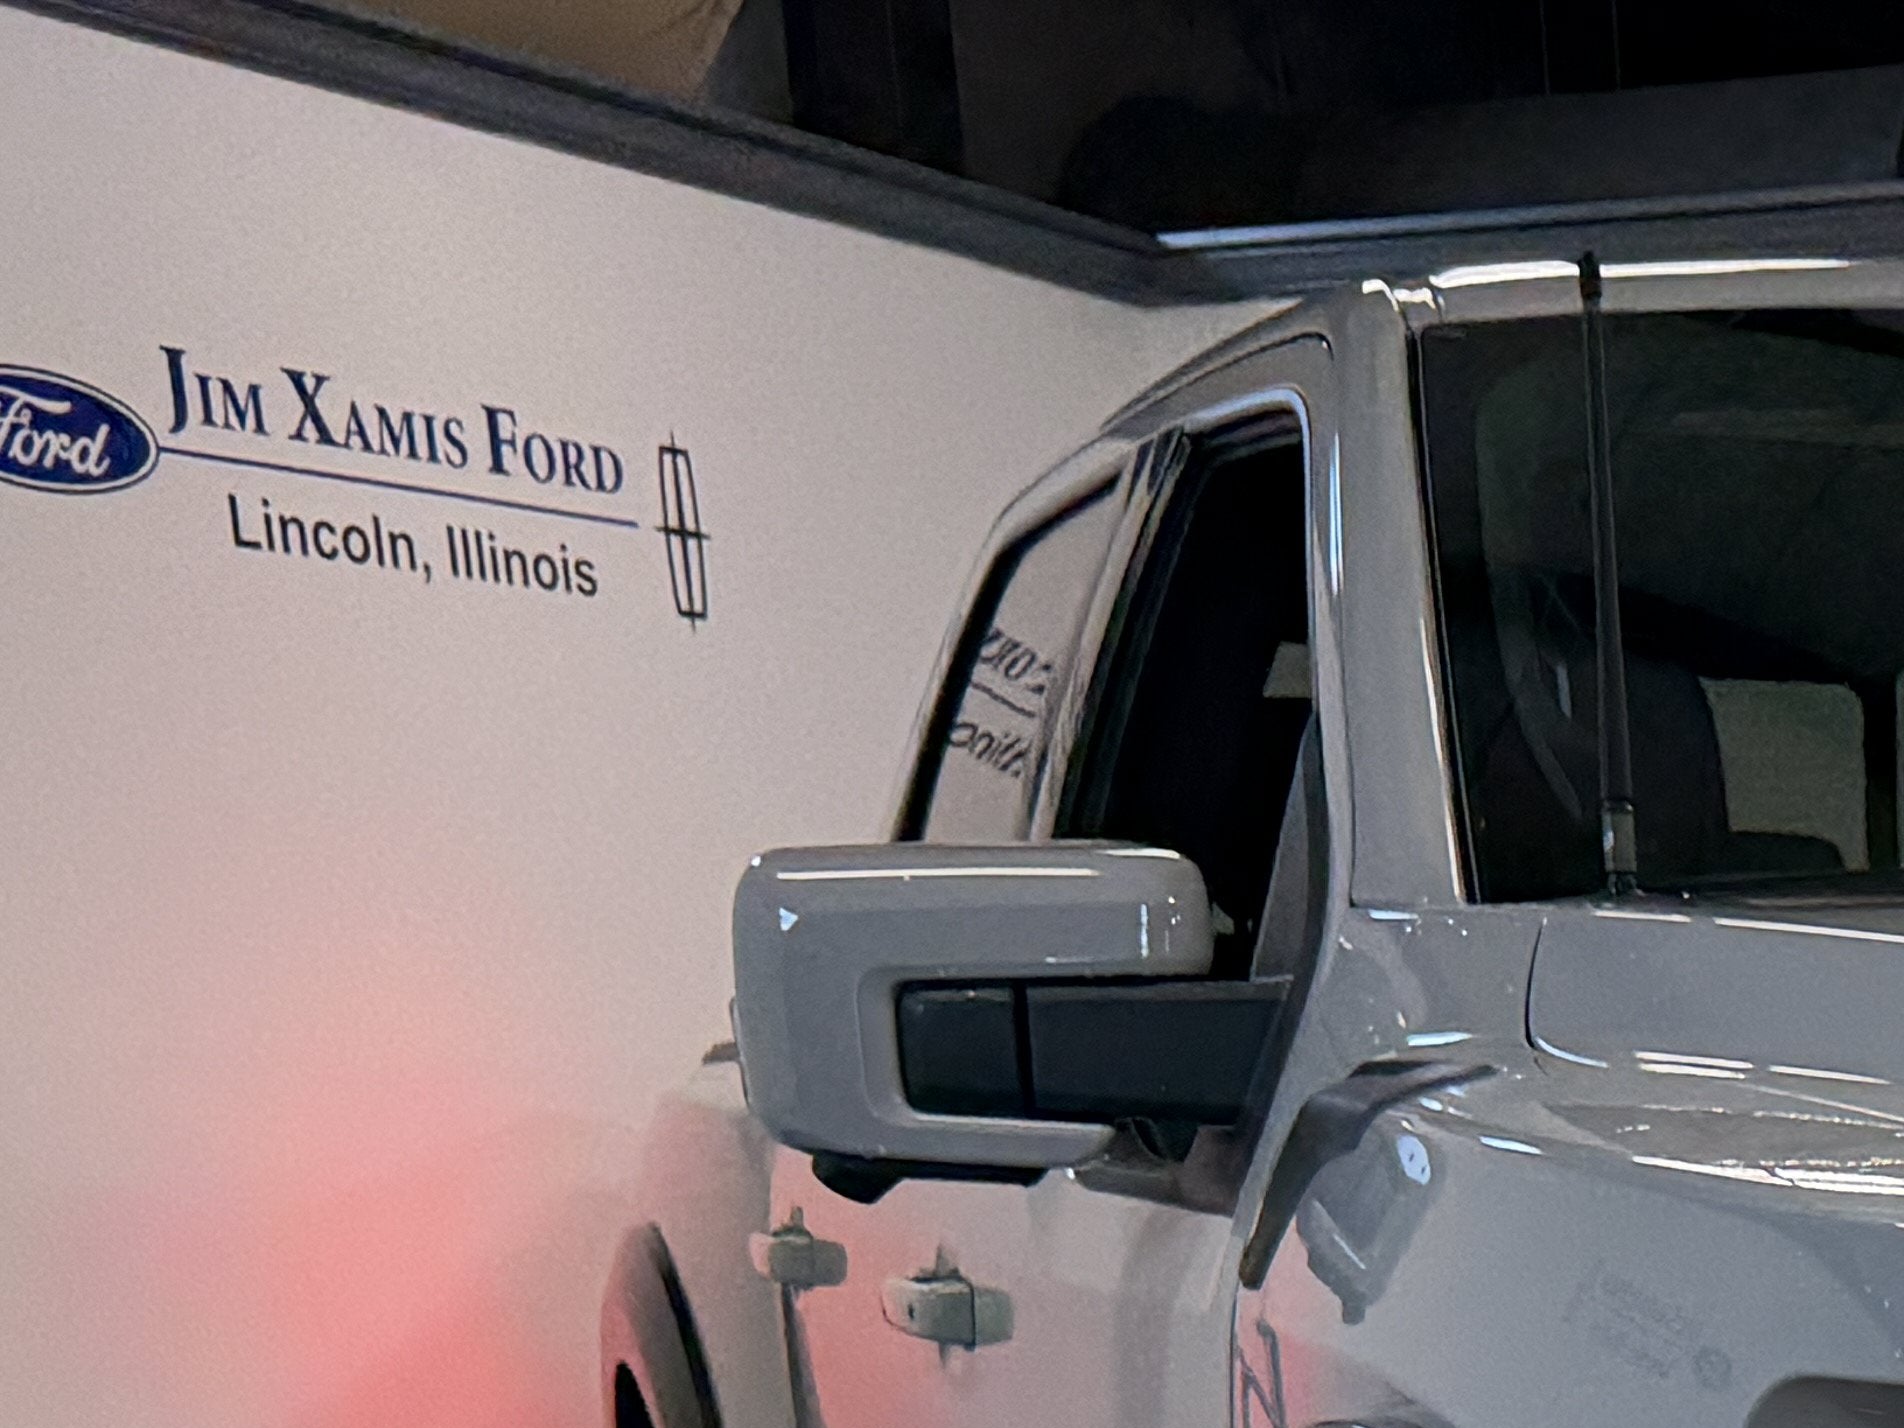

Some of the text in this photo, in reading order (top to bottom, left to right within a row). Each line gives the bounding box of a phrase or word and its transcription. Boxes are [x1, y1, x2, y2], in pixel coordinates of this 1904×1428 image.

[158, 344, 624, 495] JIM XAMIS FORD
[227, 493, 600, 598] Lincoln, Illinois
